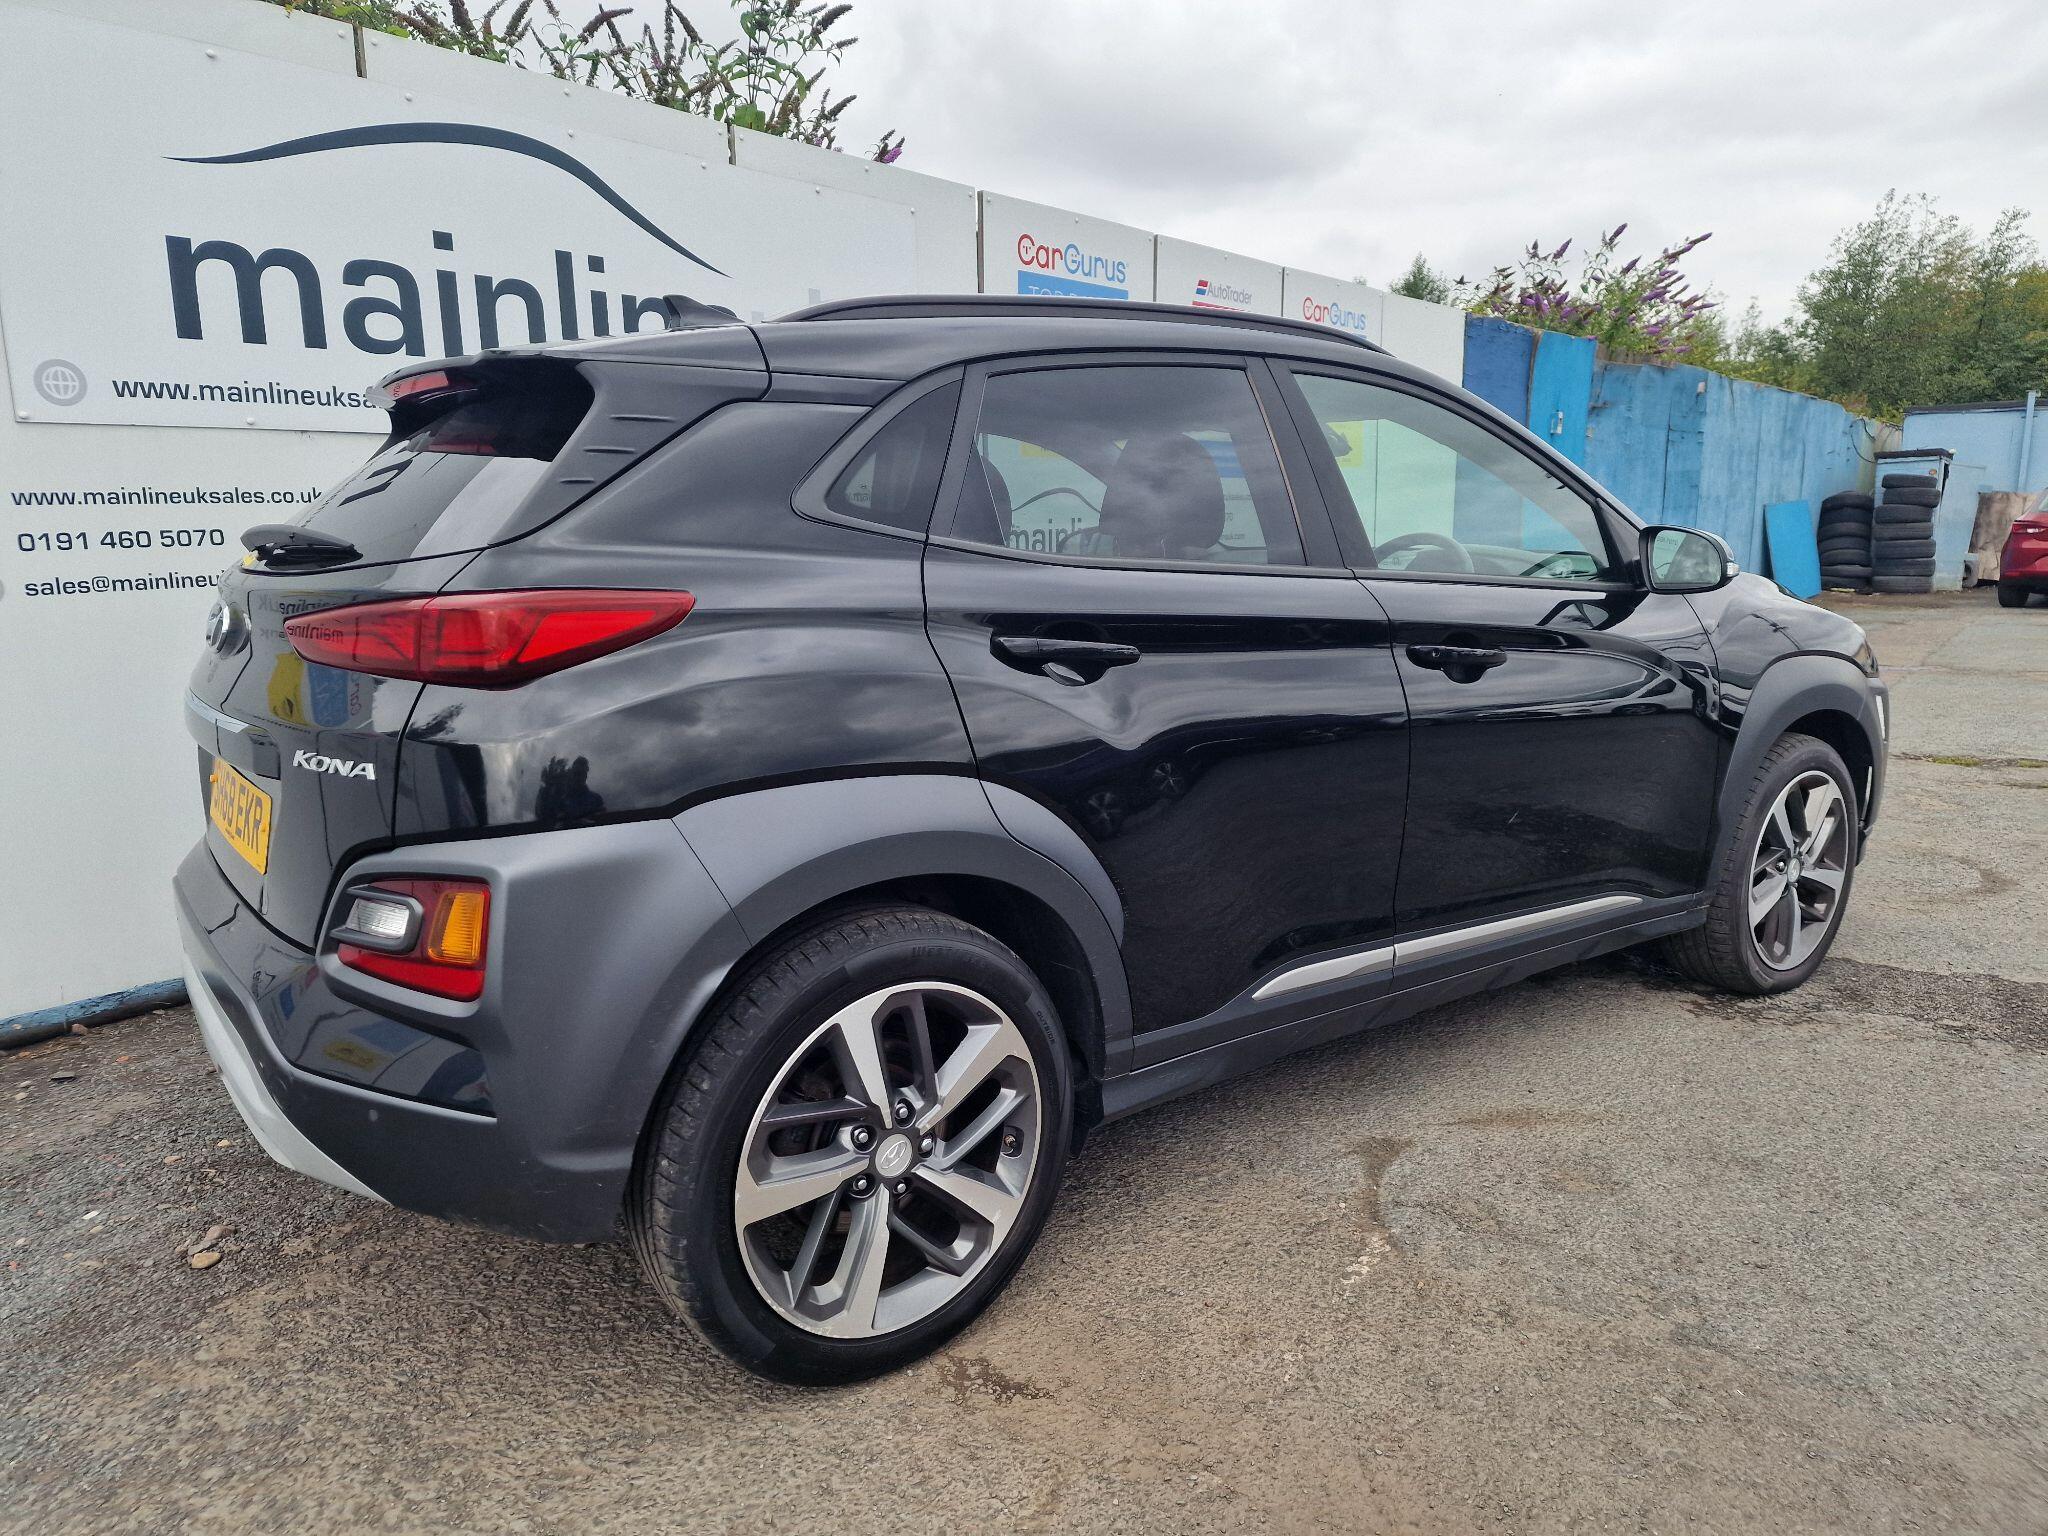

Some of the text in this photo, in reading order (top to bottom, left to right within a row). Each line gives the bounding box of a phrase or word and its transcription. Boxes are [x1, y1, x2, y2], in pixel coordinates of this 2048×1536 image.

[1017, 233, 1126, 284] CarGurus
[165, 230, 738, 358] mainlin
[1207, 281, 1252, 305] AutoTrader
[1302, 296, 1367, 331] CarGurus
[112, 379, 377, 408] www.mainlineuksa
[11, 486, 322, 506] www.mainlineuksales.co.uk
[17, 528, 225, 552] 0191 460 5070
[25, 570, 224, 596] sales@mainlineu
[293, 749, 376, 780] KONA
[234, 783, 263, 854] EKR
